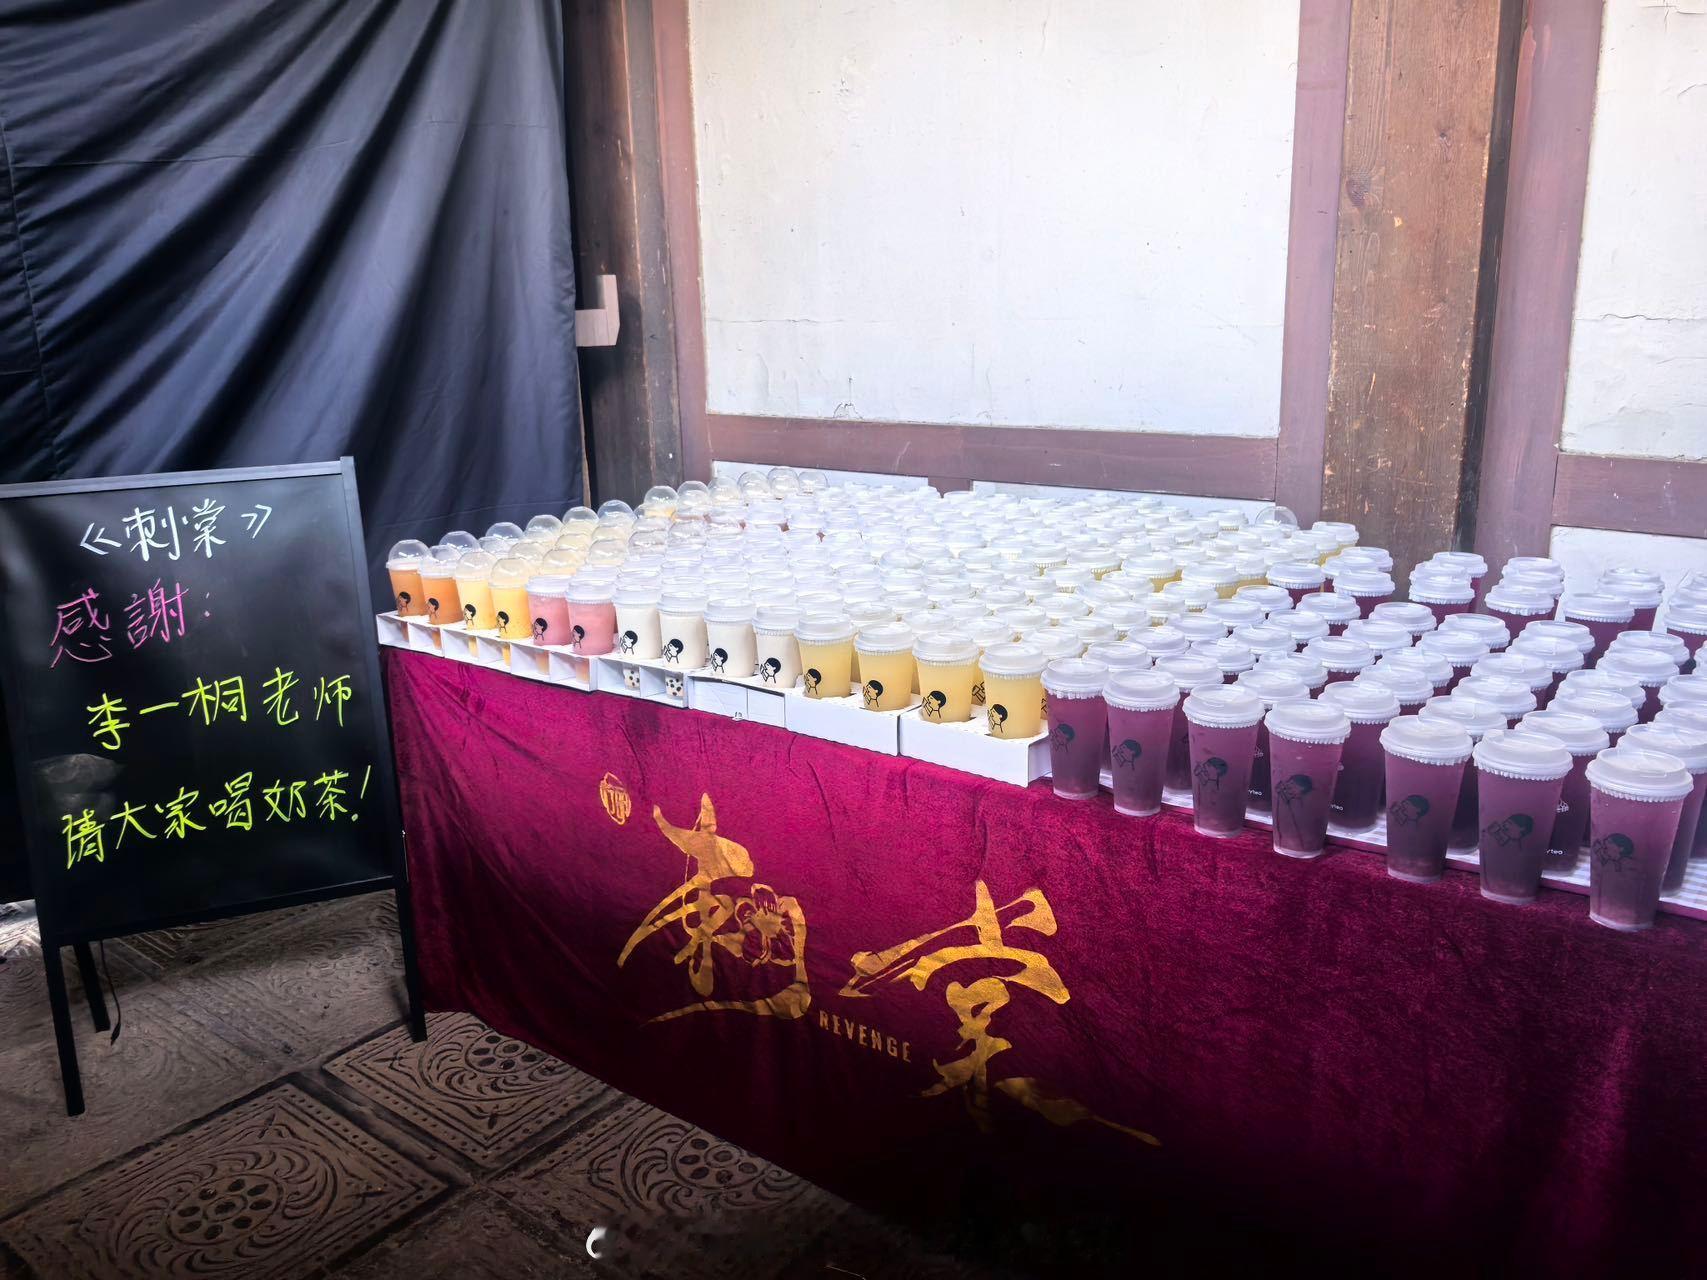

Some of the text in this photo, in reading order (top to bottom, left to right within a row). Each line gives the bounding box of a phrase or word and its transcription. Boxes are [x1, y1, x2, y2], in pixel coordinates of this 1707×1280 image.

[86, 667, 352, 750] 李一桐老师
[818, 1009, 912, 1063] REVENGE
